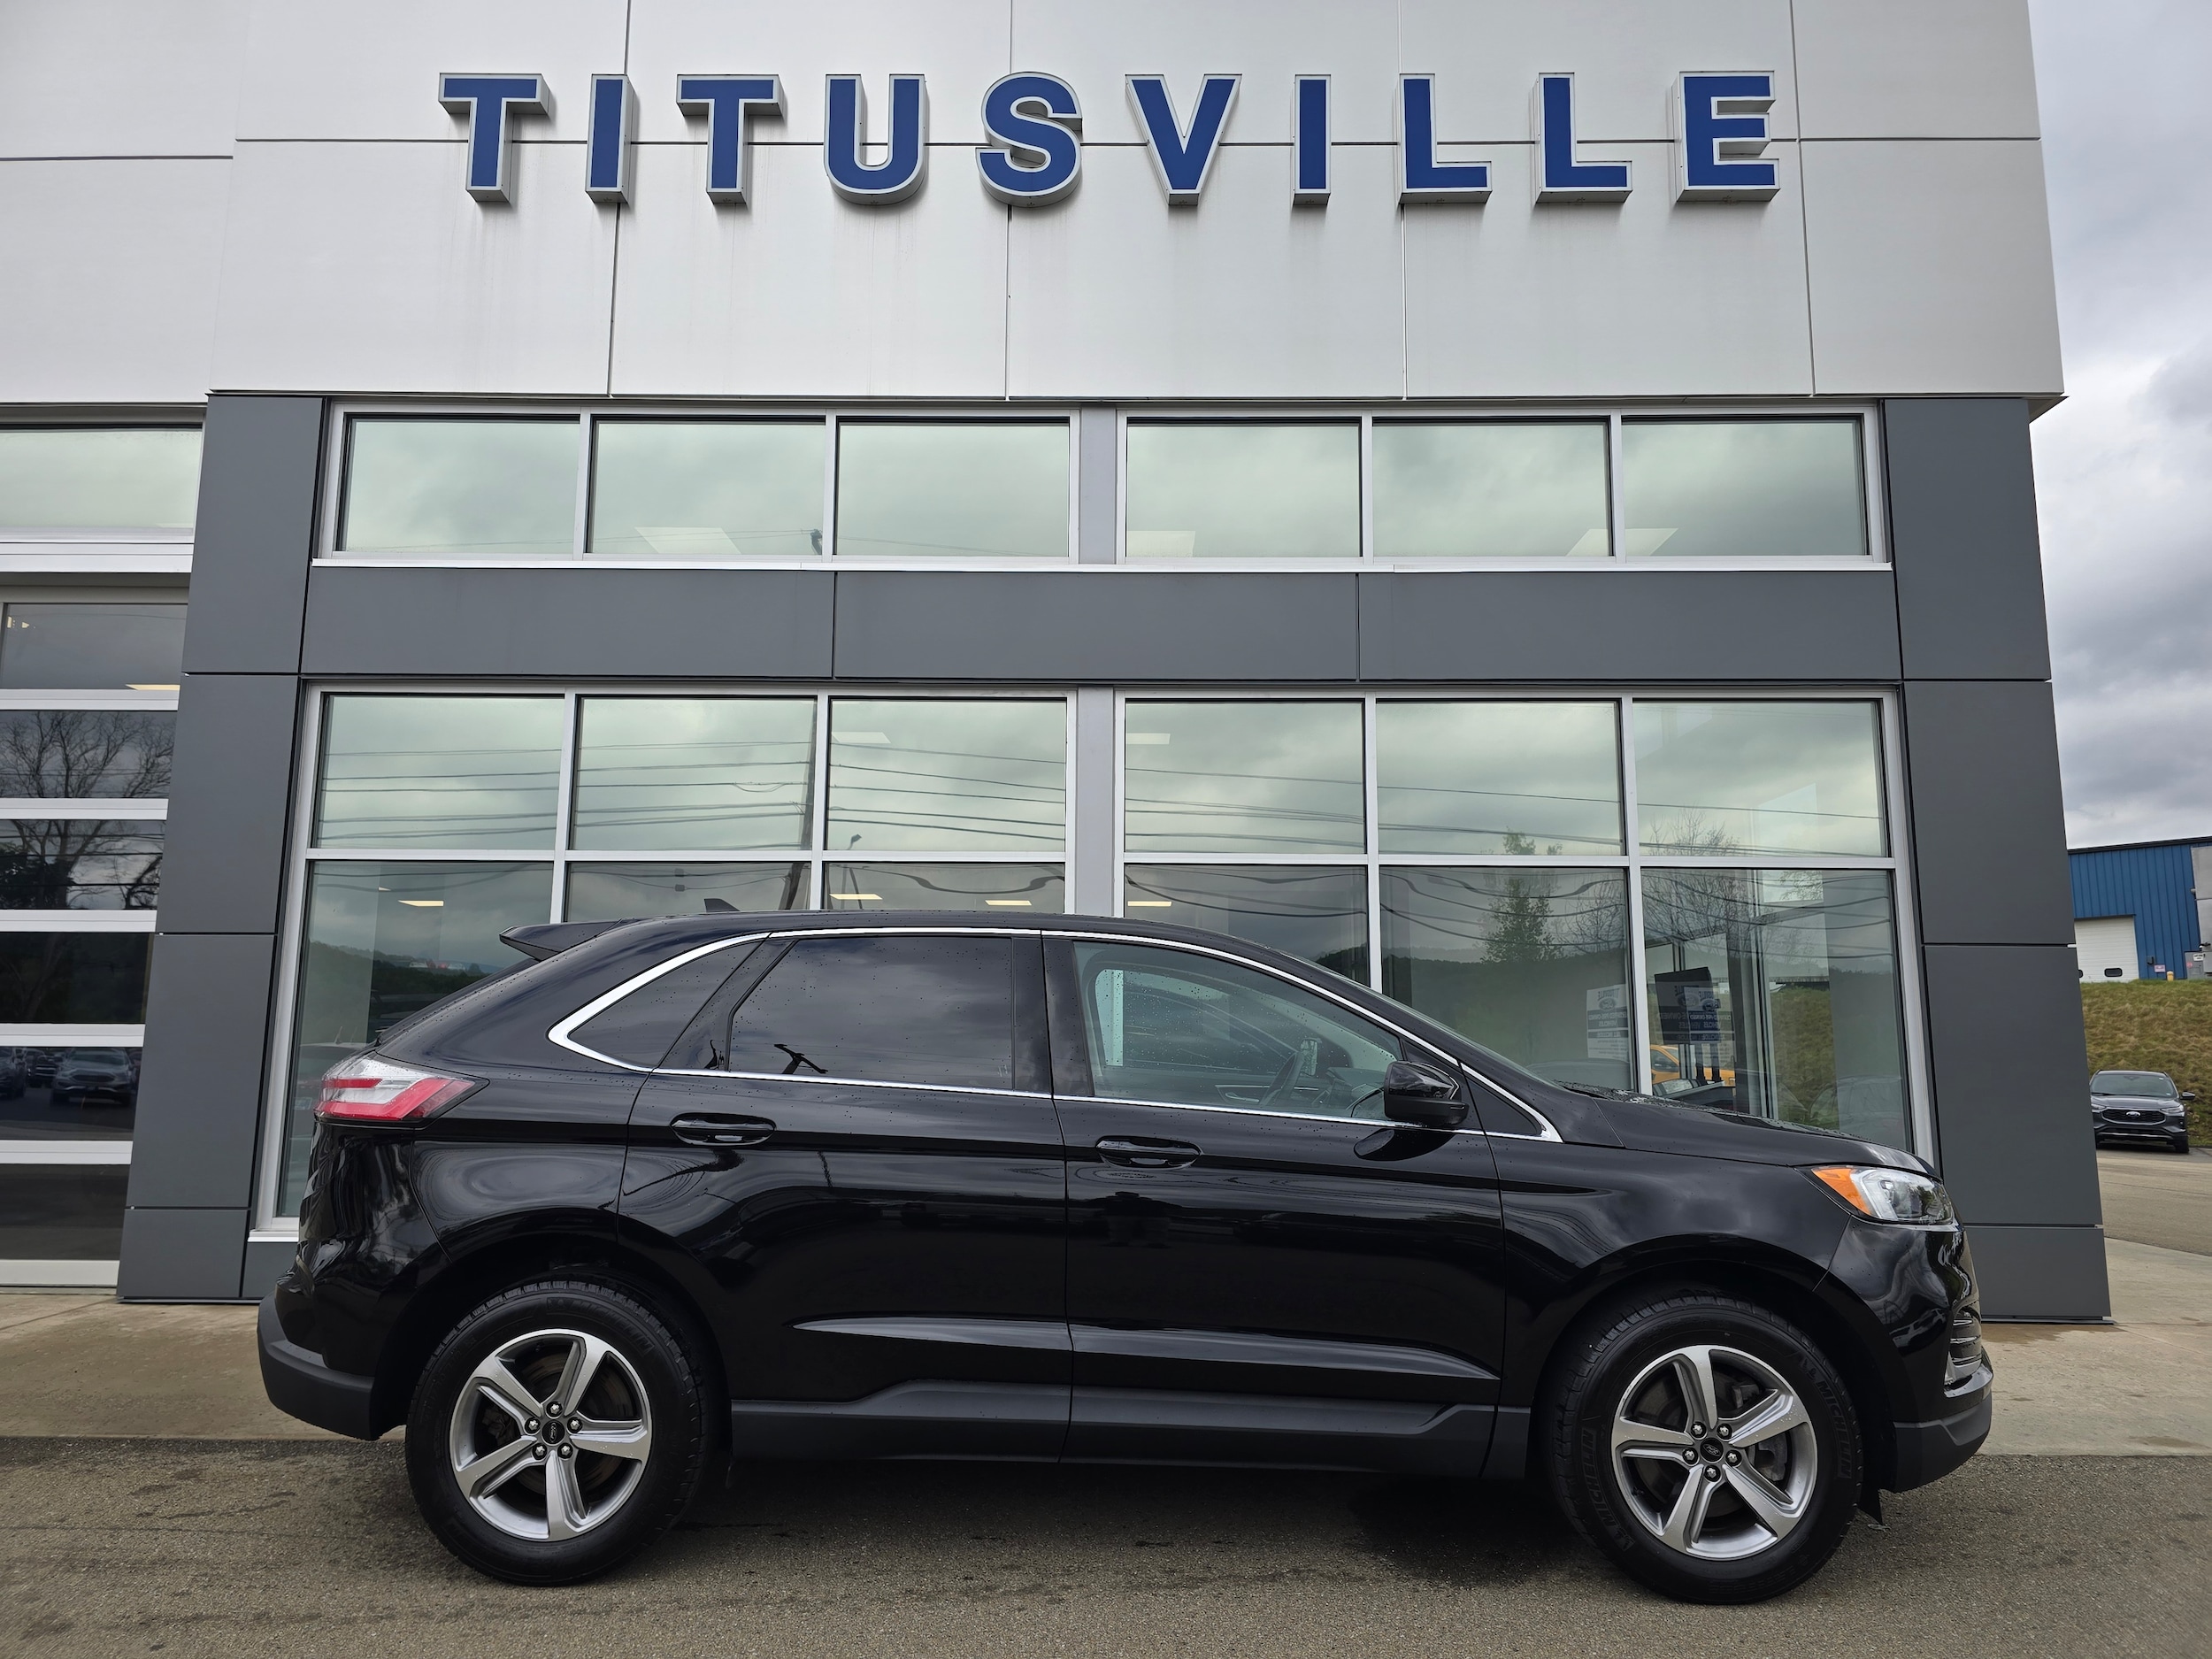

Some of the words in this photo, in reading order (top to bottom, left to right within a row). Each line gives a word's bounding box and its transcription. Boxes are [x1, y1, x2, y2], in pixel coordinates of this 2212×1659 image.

[438, 71, 1780, 206] TITUSVILLE
[1818, 1379, 1853, 1479] MICHELIN
[1582, 1430, 1618, 1530] MICHELIN
